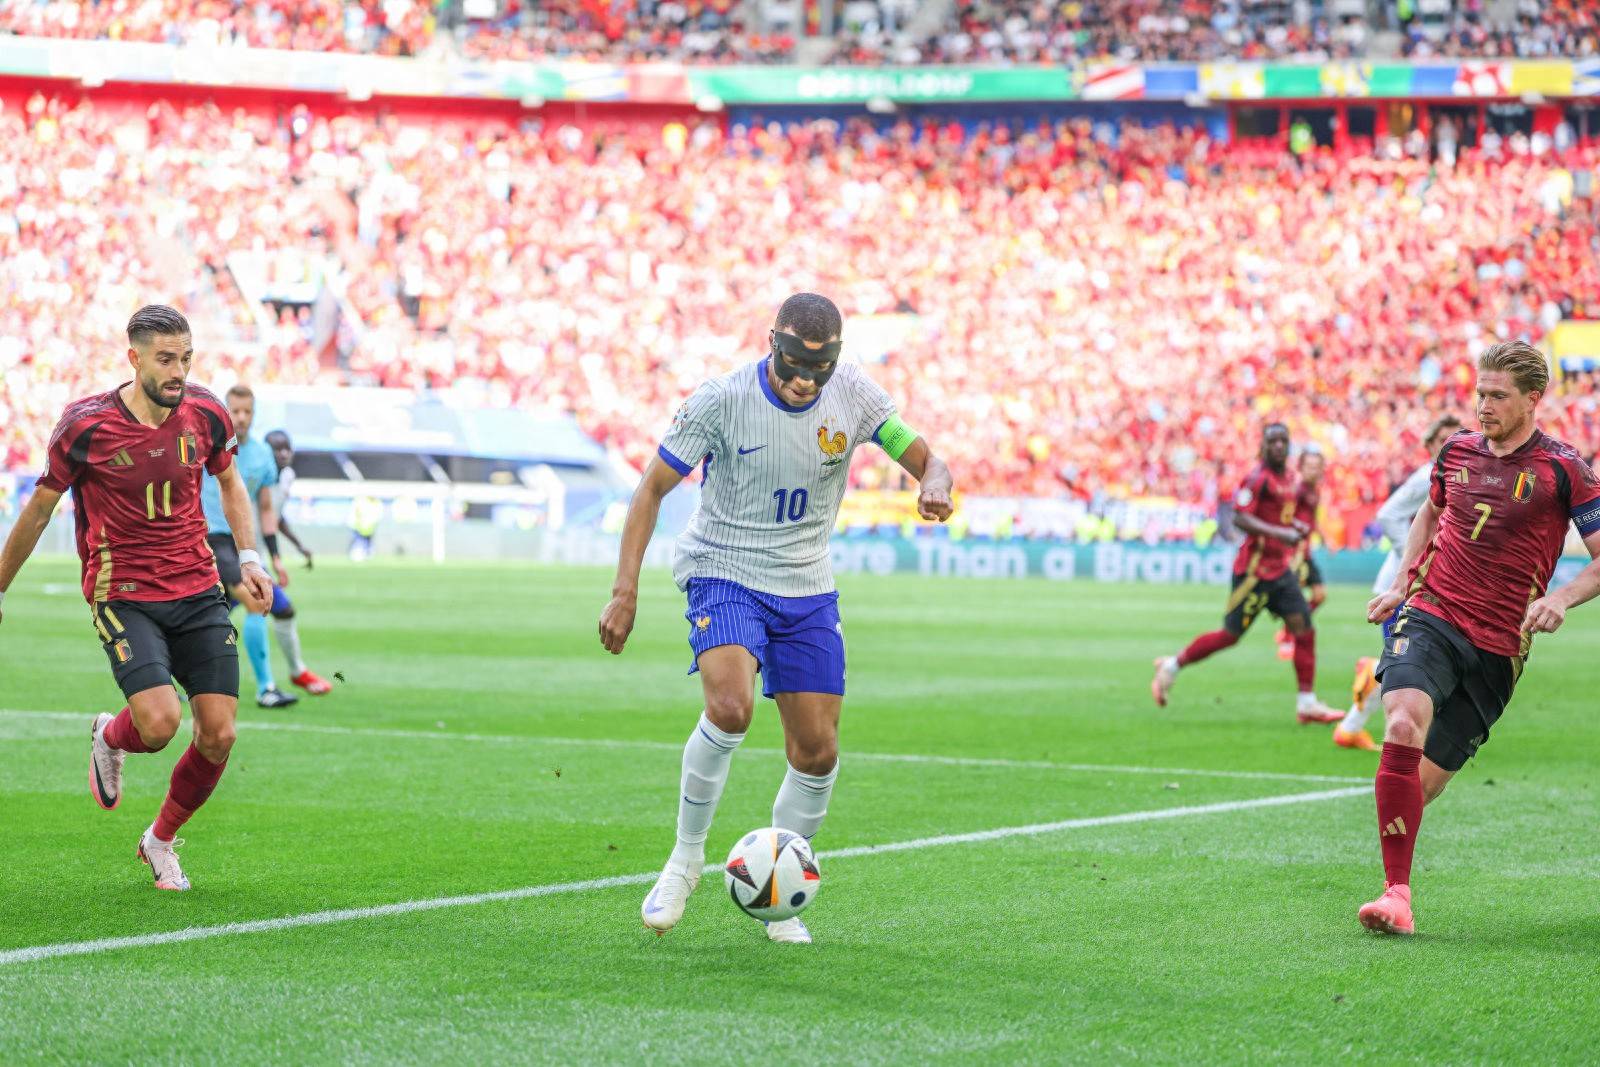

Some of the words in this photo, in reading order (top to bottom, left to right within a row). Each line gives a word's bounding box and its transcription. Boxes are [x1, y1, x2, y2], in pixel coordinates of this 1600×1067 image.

[146, 480, 172, 520] 11
[773, 488, 808, 524] 10
[1471, 502, 1492, 540] 7
[829, 540, 897, 575] ore
[915, 537, 1028, 578] Than
[1042, 546, 1075, 582] a
[1094, 543, 1233, 585] Brand
